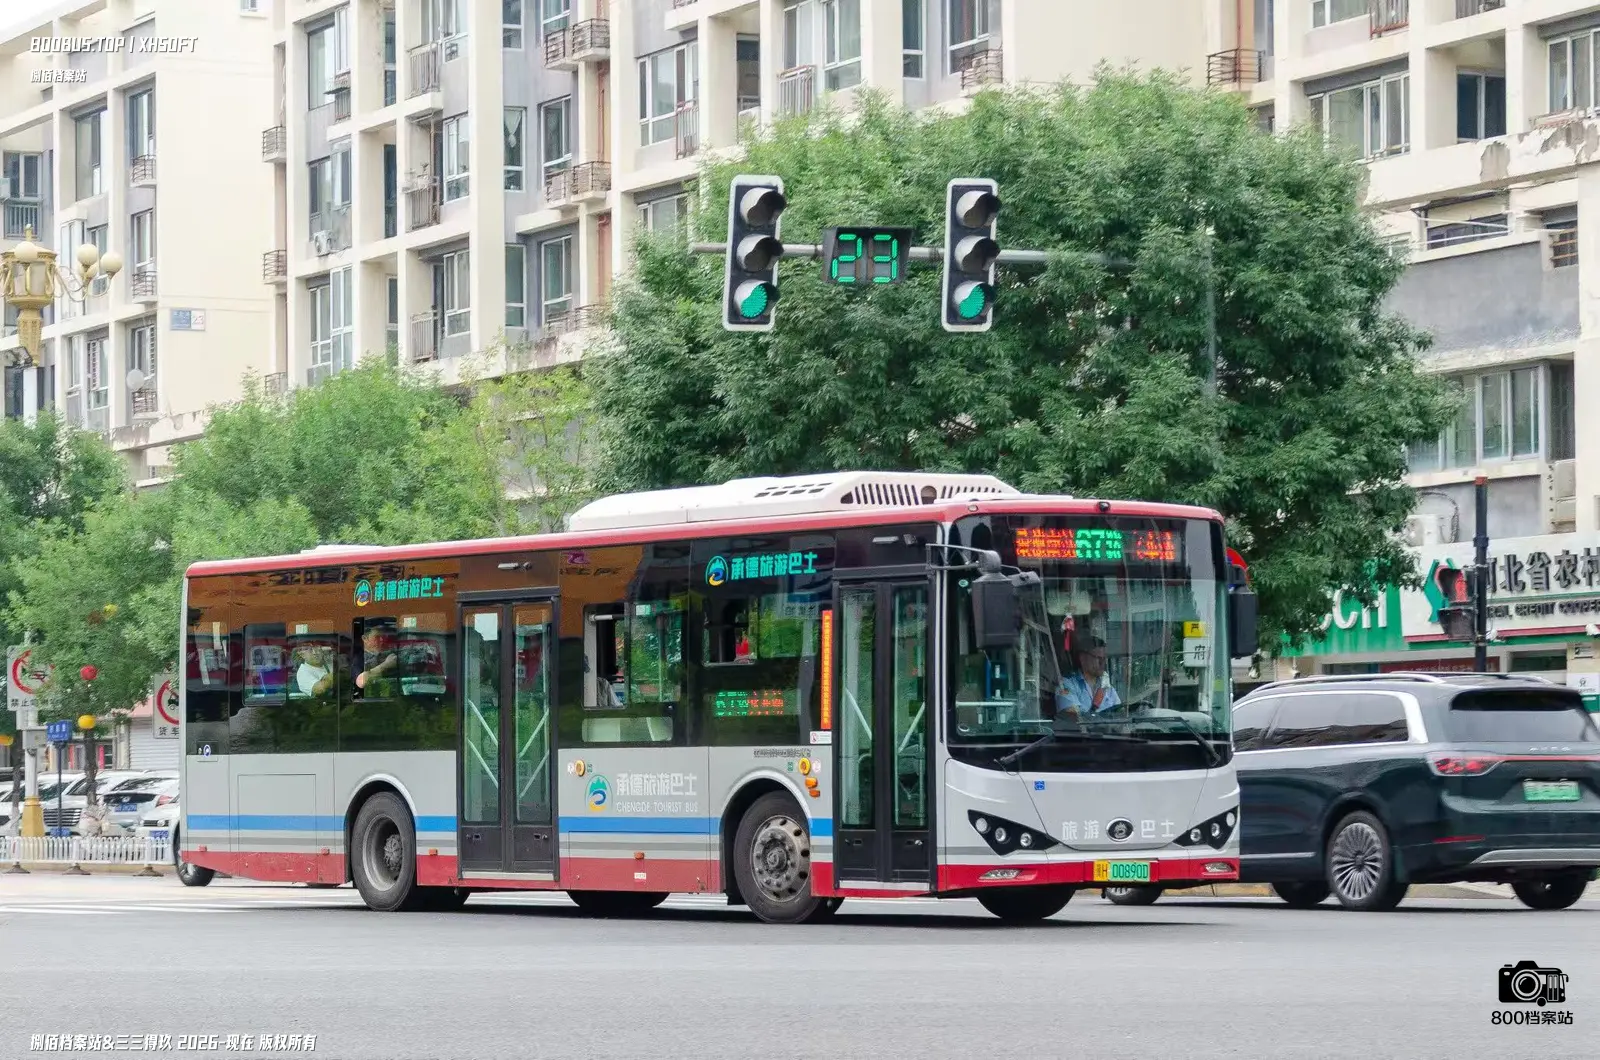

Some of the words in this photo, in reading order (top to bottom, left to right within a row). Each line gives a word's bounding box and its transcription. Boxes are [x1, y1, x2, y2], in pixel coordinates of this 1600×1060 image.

[831, 233, 898, 284] 23
[731, 552, 818, 580] 承德旅游巴士
[374, 577, 445, 602] 承德旅游巴士
[616, 773, 698, 796] 承德旅游巴士
[616, 802, 650, 813] CHENGDE
[654, 802, 682, 812] TOURIST
[685, 802, 698, 812] BUS
[1061, 820, 1099, 840] 旅游
[1140, 820, 1175, 838] 巴士
